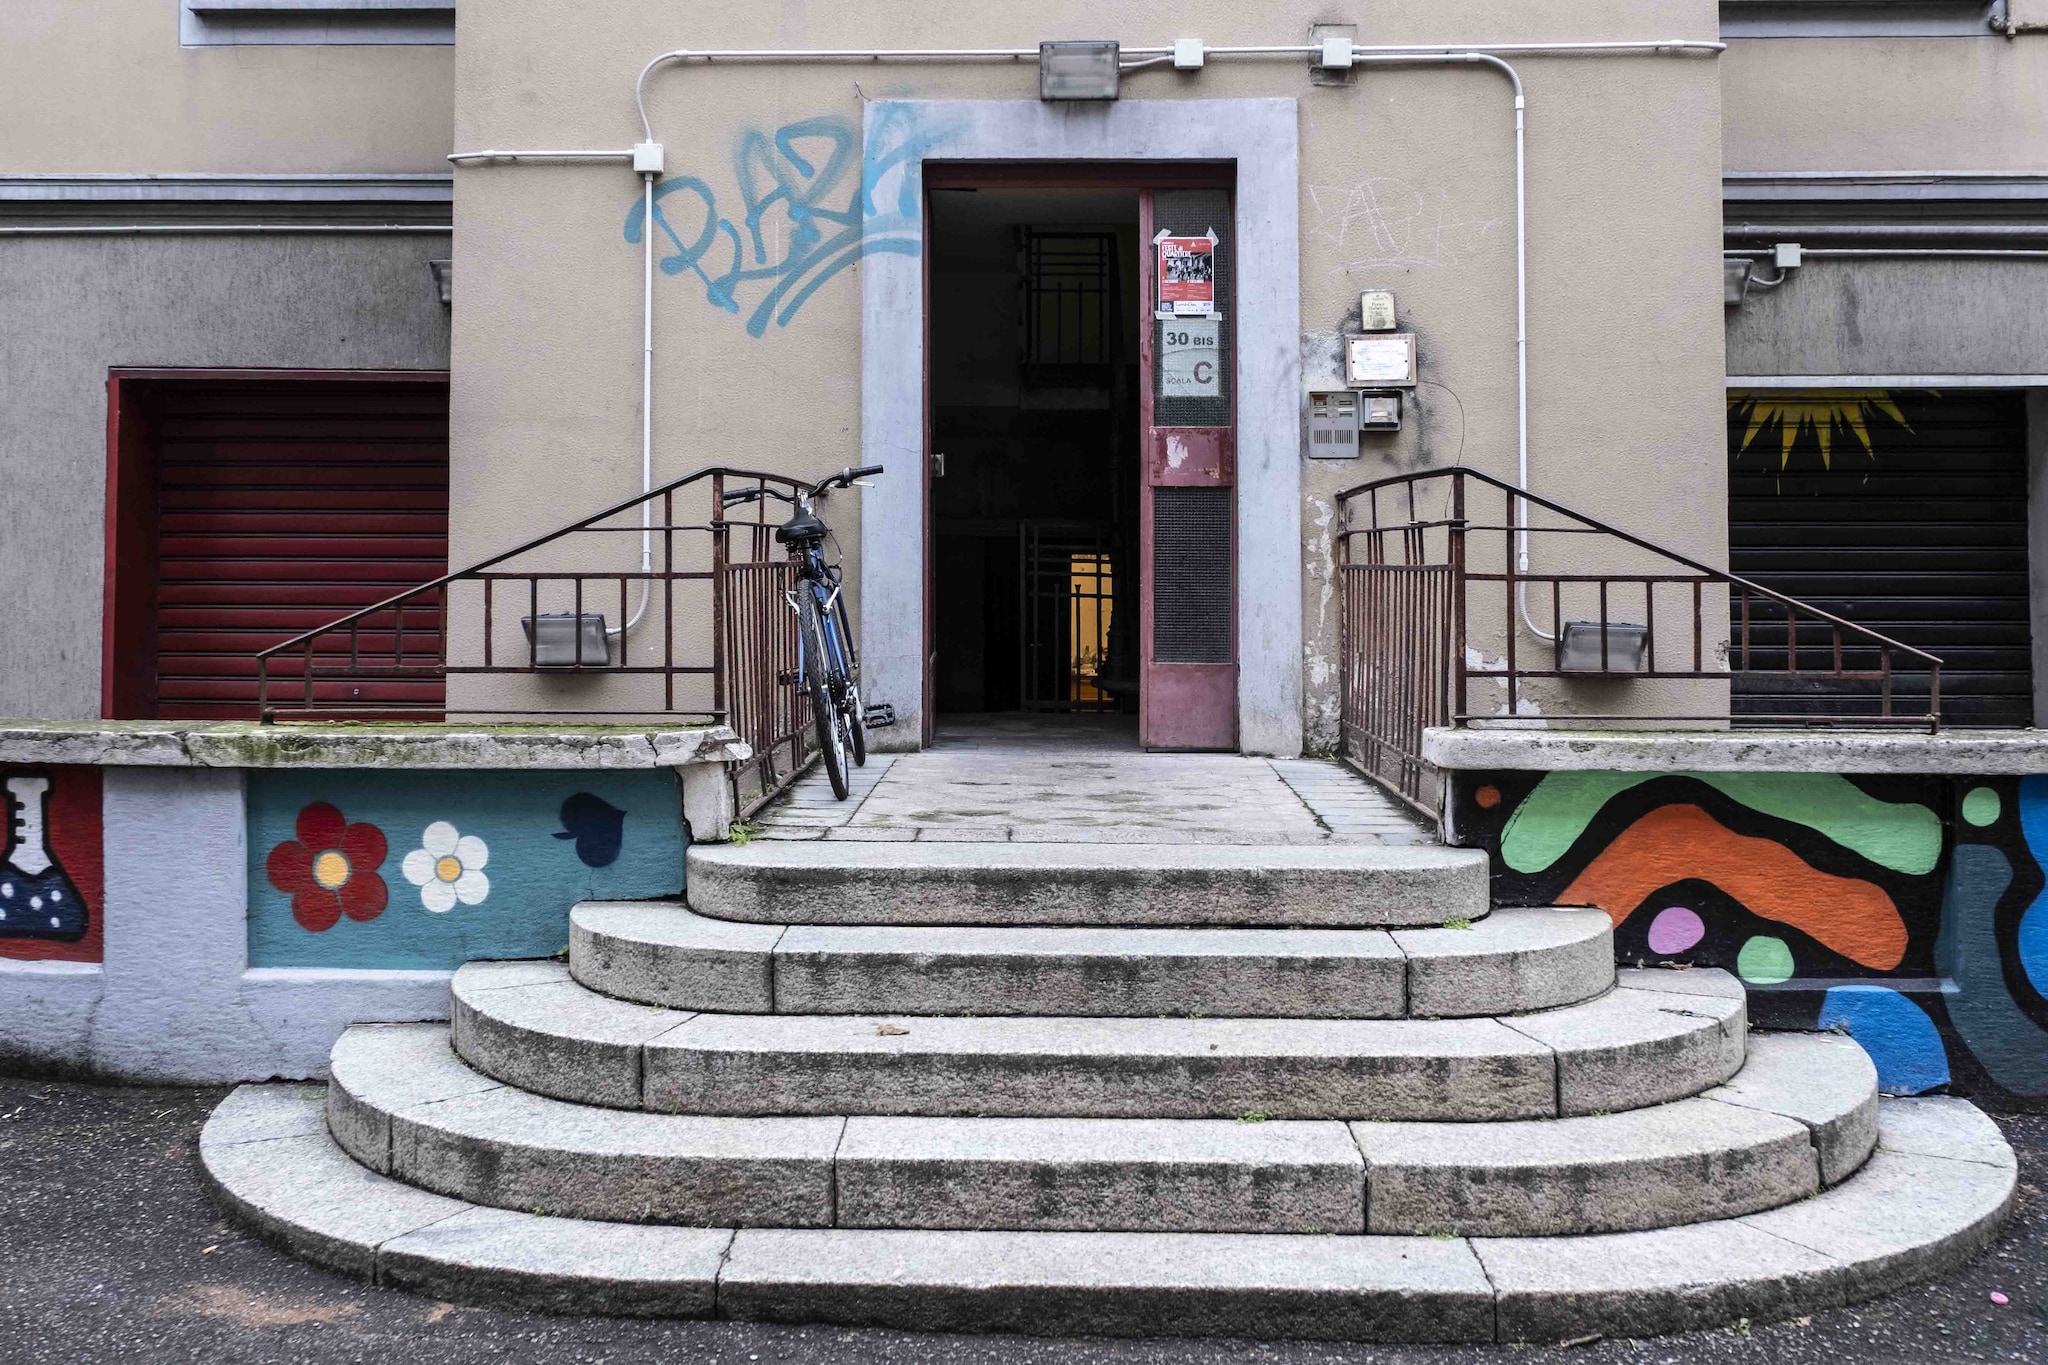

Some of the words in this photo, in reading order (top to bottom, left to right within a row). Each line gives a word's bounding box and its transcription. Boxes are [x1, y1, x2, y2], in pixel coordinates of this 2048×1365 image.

[1166, 332, 1189, 346] 30
[1193, 337, 1214, 346] BIS
[1165, 377, 1192, 385] SCALA
[1193, 361, 1213, 385] C
